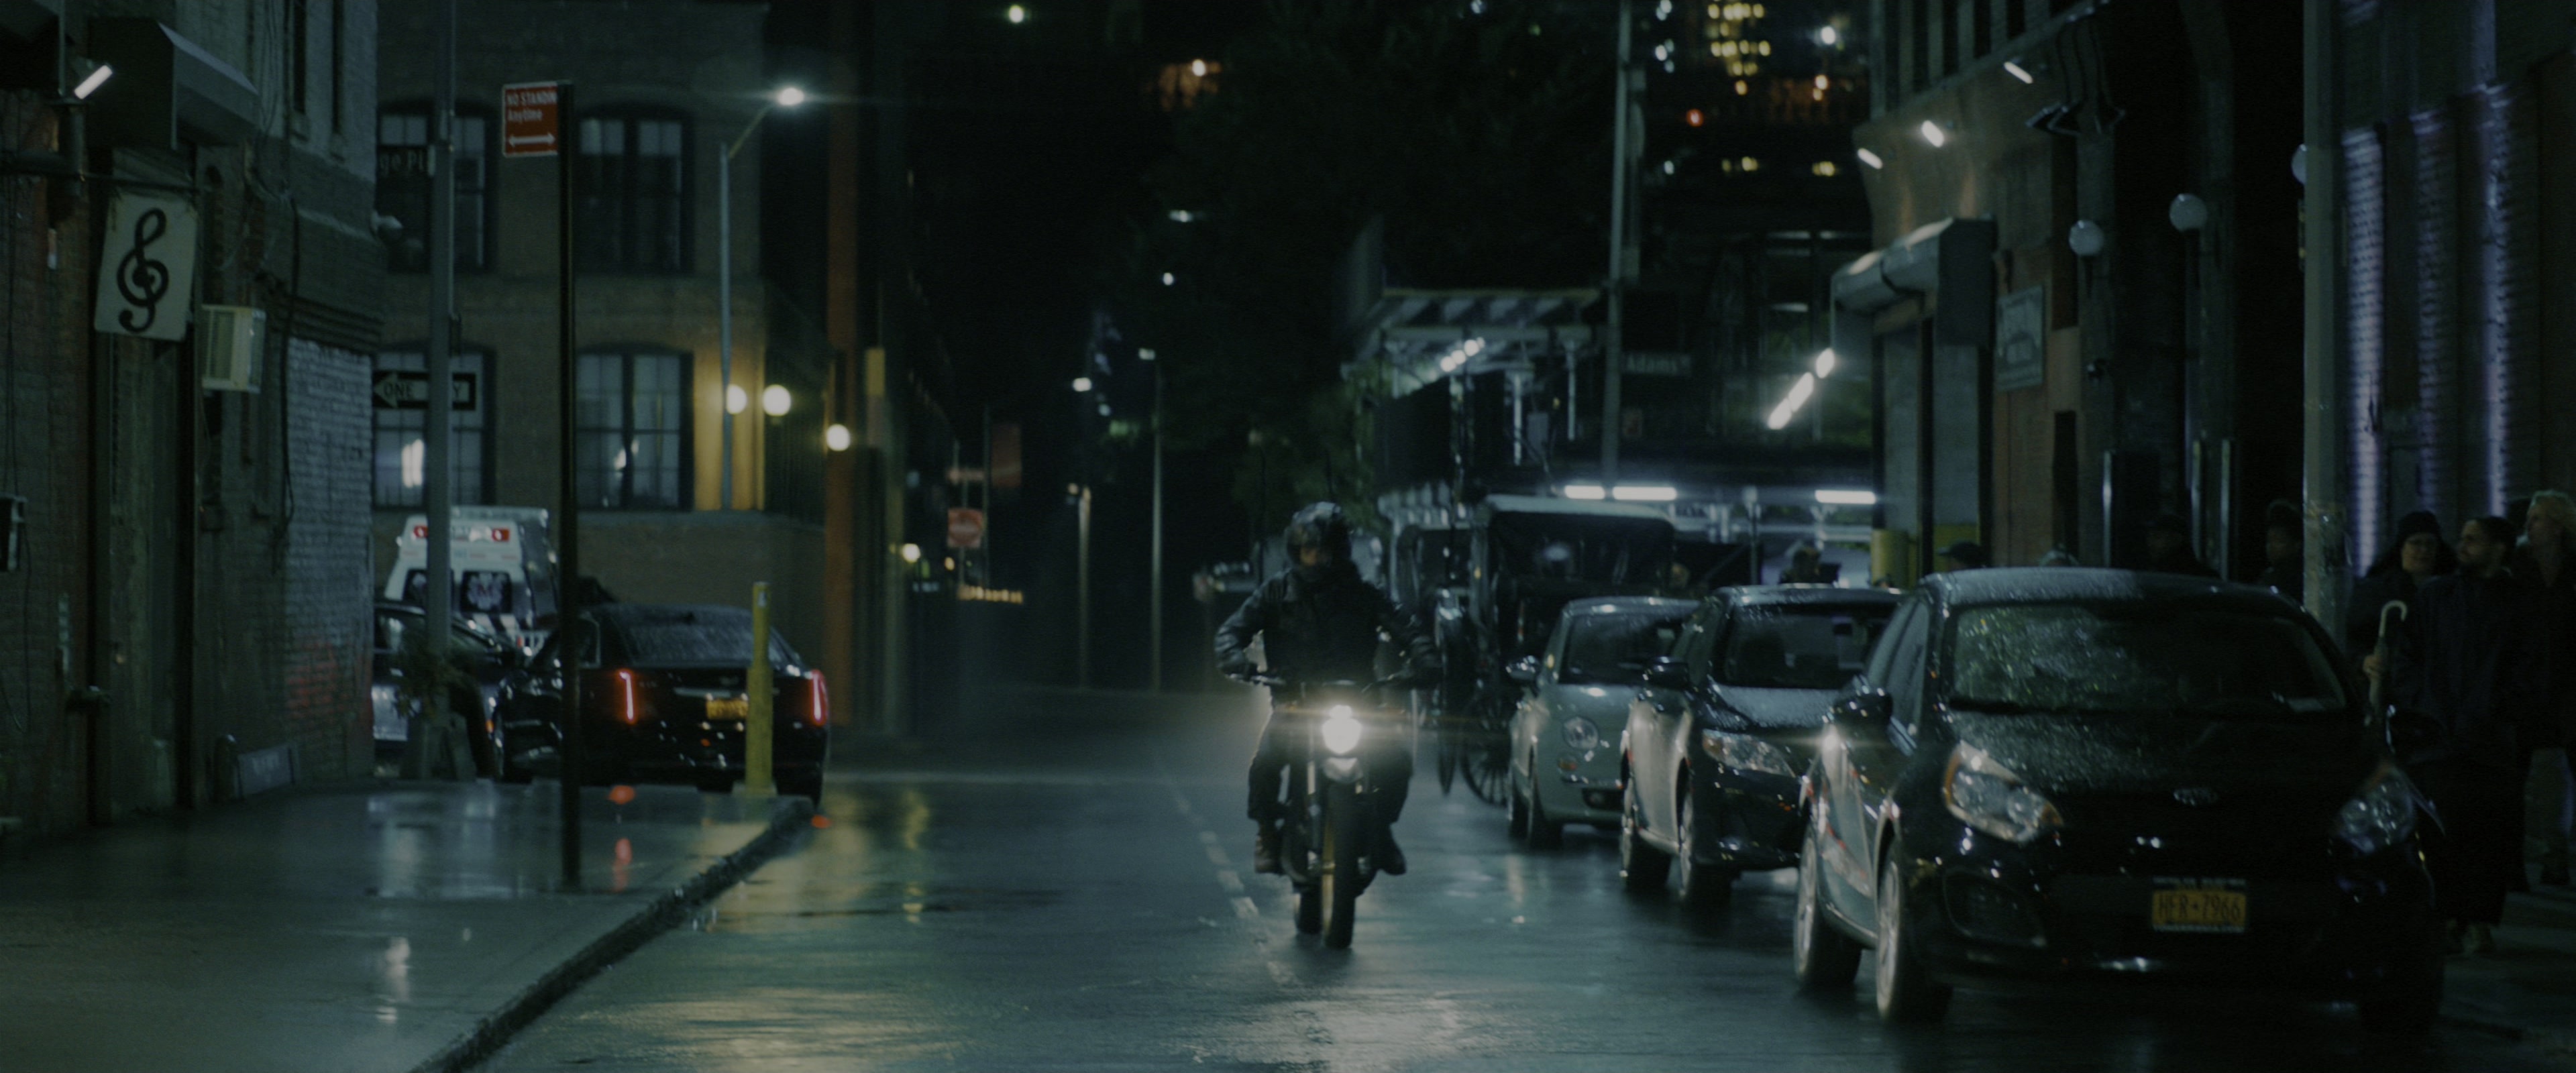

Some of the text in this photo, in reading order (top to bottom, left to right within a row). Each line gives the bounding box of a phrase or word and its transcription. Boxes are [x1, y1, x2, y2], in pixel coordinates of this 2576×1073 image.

[507, 91, 558, 107] NO STANDIN
[508, 109, 543, 124] Anytime
[384, 382, 411, 398] ONE
